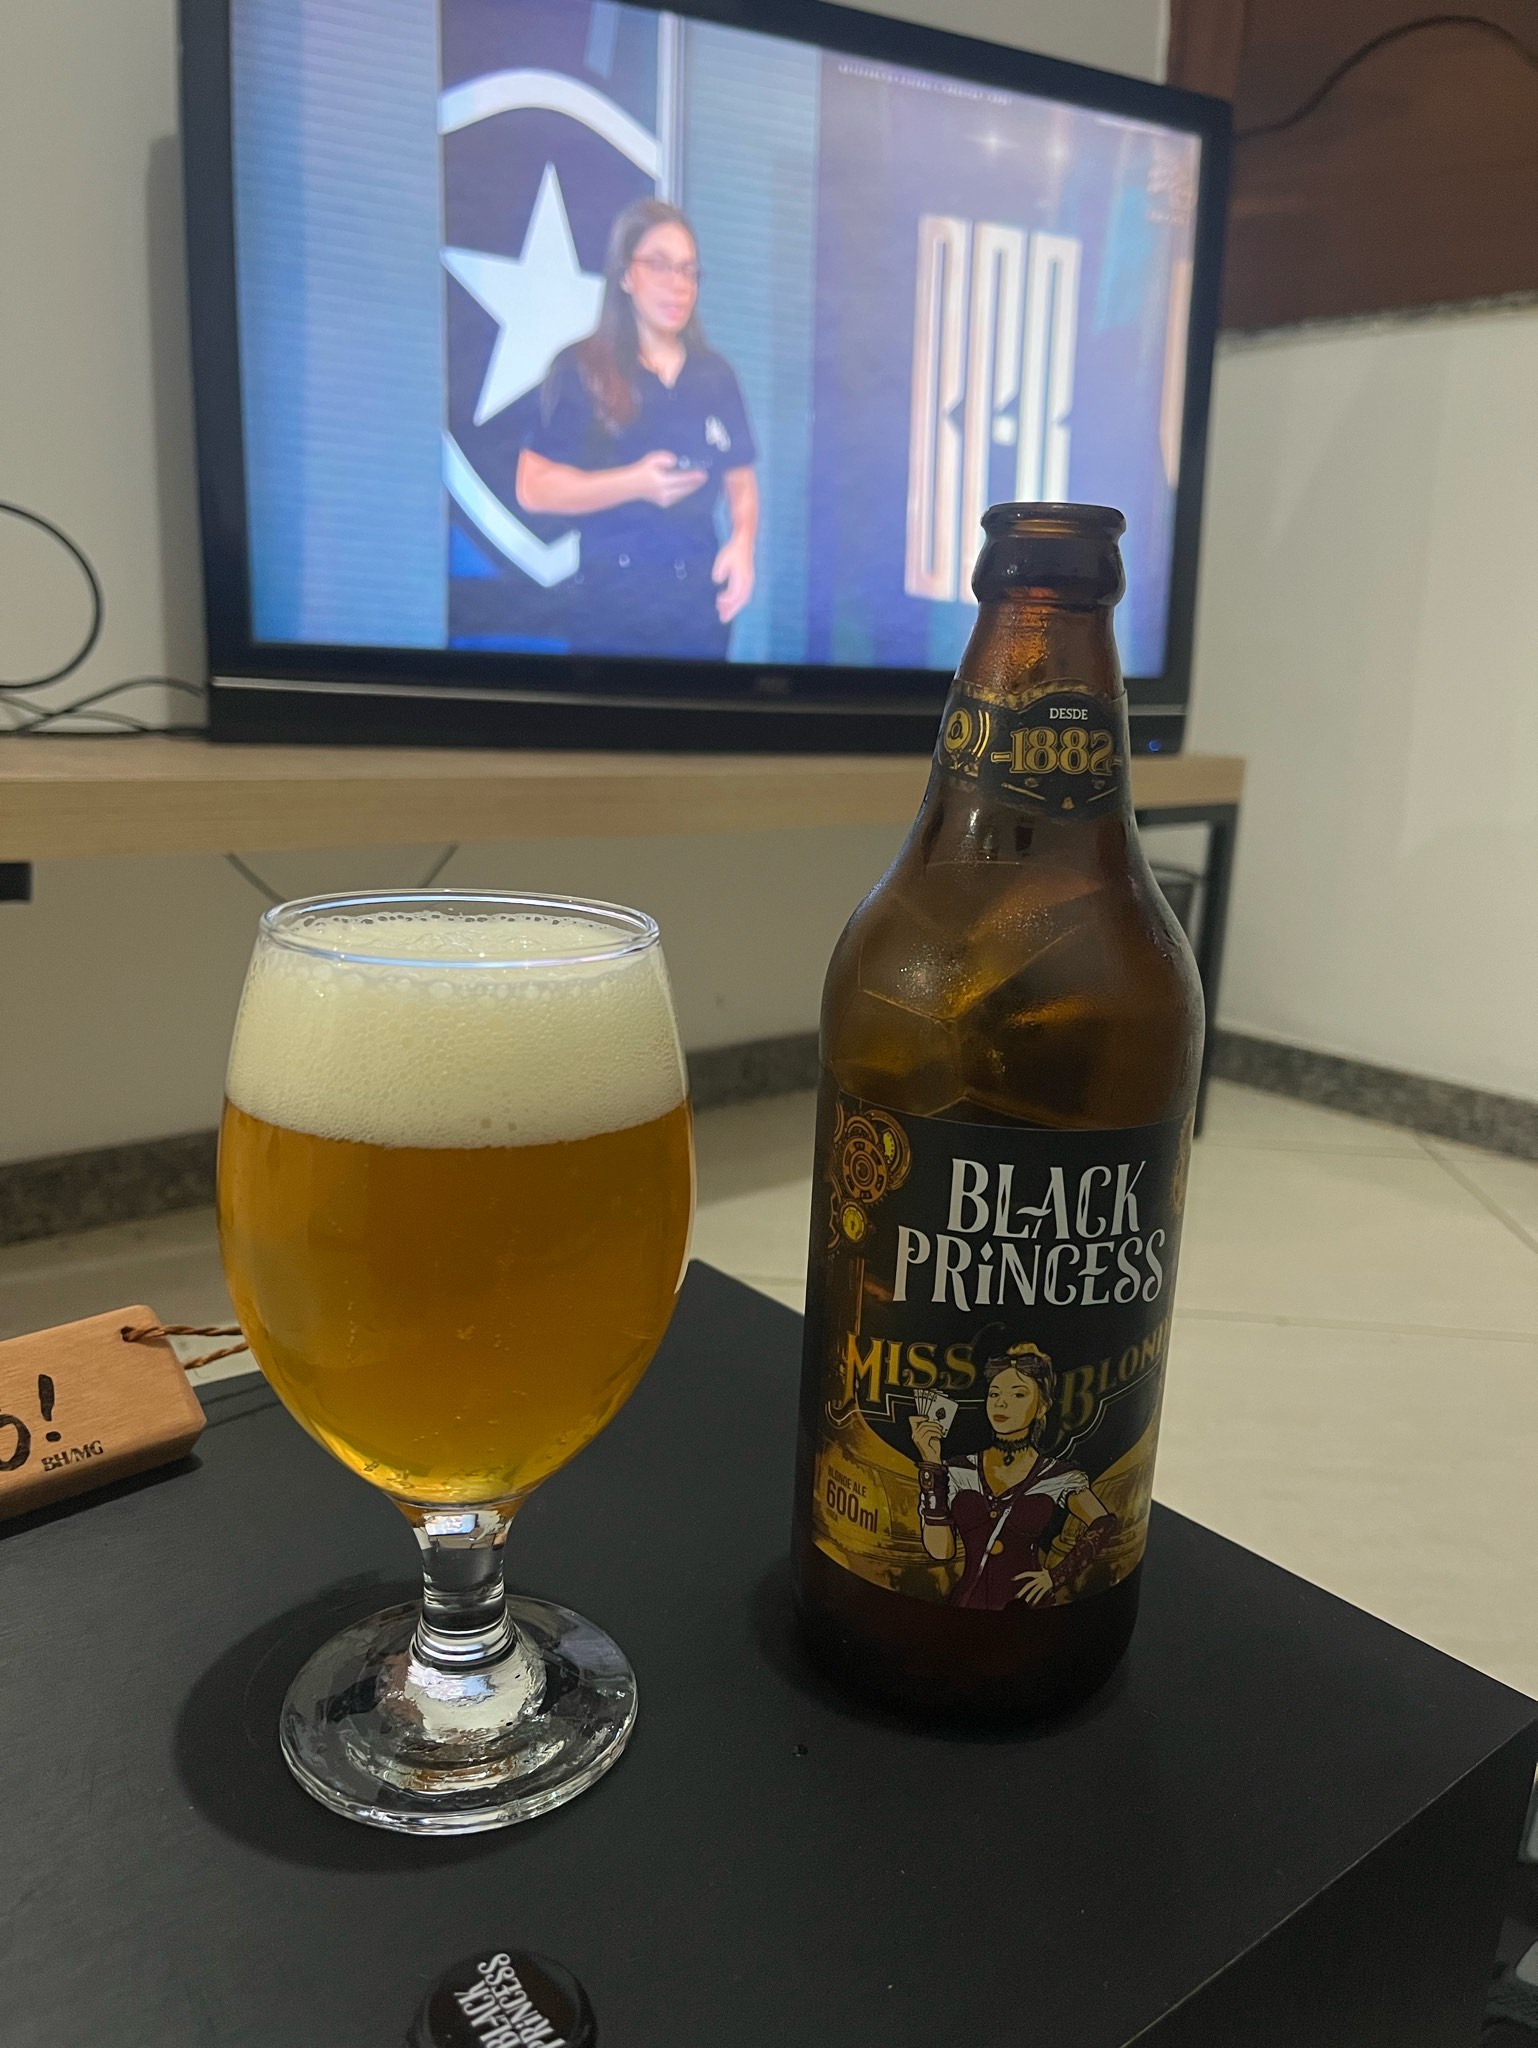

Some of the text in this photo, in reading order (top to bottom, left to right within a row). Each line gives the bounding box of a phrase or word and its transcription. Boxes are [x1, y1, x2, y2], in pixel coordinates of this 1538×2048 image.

[1049, 707, 1089, 721] DESDE
[1009, 726, 1114, 776] 1882
[946, 1157, 1147, 1240] BLACK
[838, 1330, 977, 1408] MISS
[826, 1479, 878, 1534] 600ml
[852, 1481, 868, 1498] ALE
